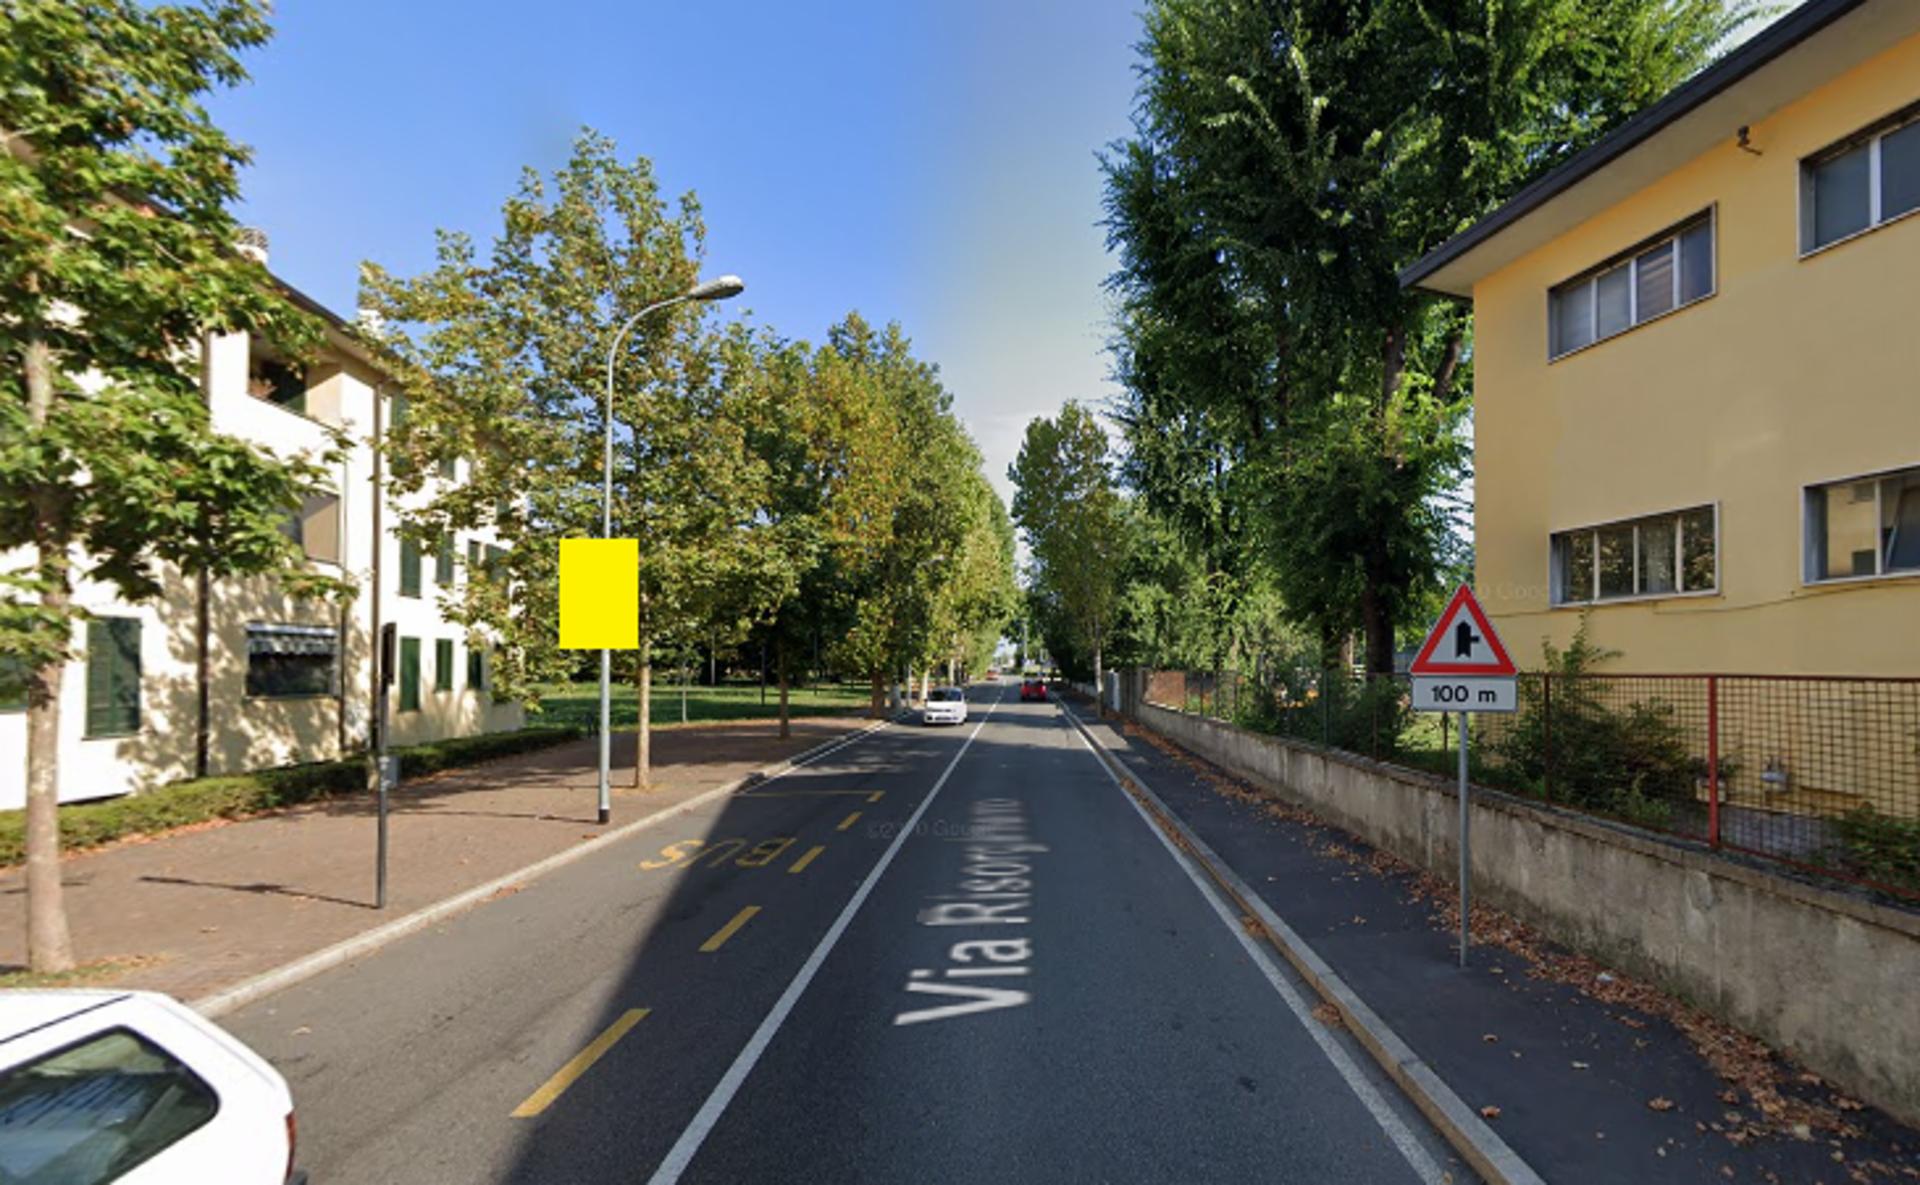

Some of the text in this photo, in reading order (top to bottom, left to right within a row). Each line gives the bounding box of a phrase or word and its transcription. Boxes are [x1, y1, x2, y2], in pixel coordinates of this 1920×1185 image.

[1431, 685, 1497, 702] 100 m
[639, 837, 797, 871] BUS
